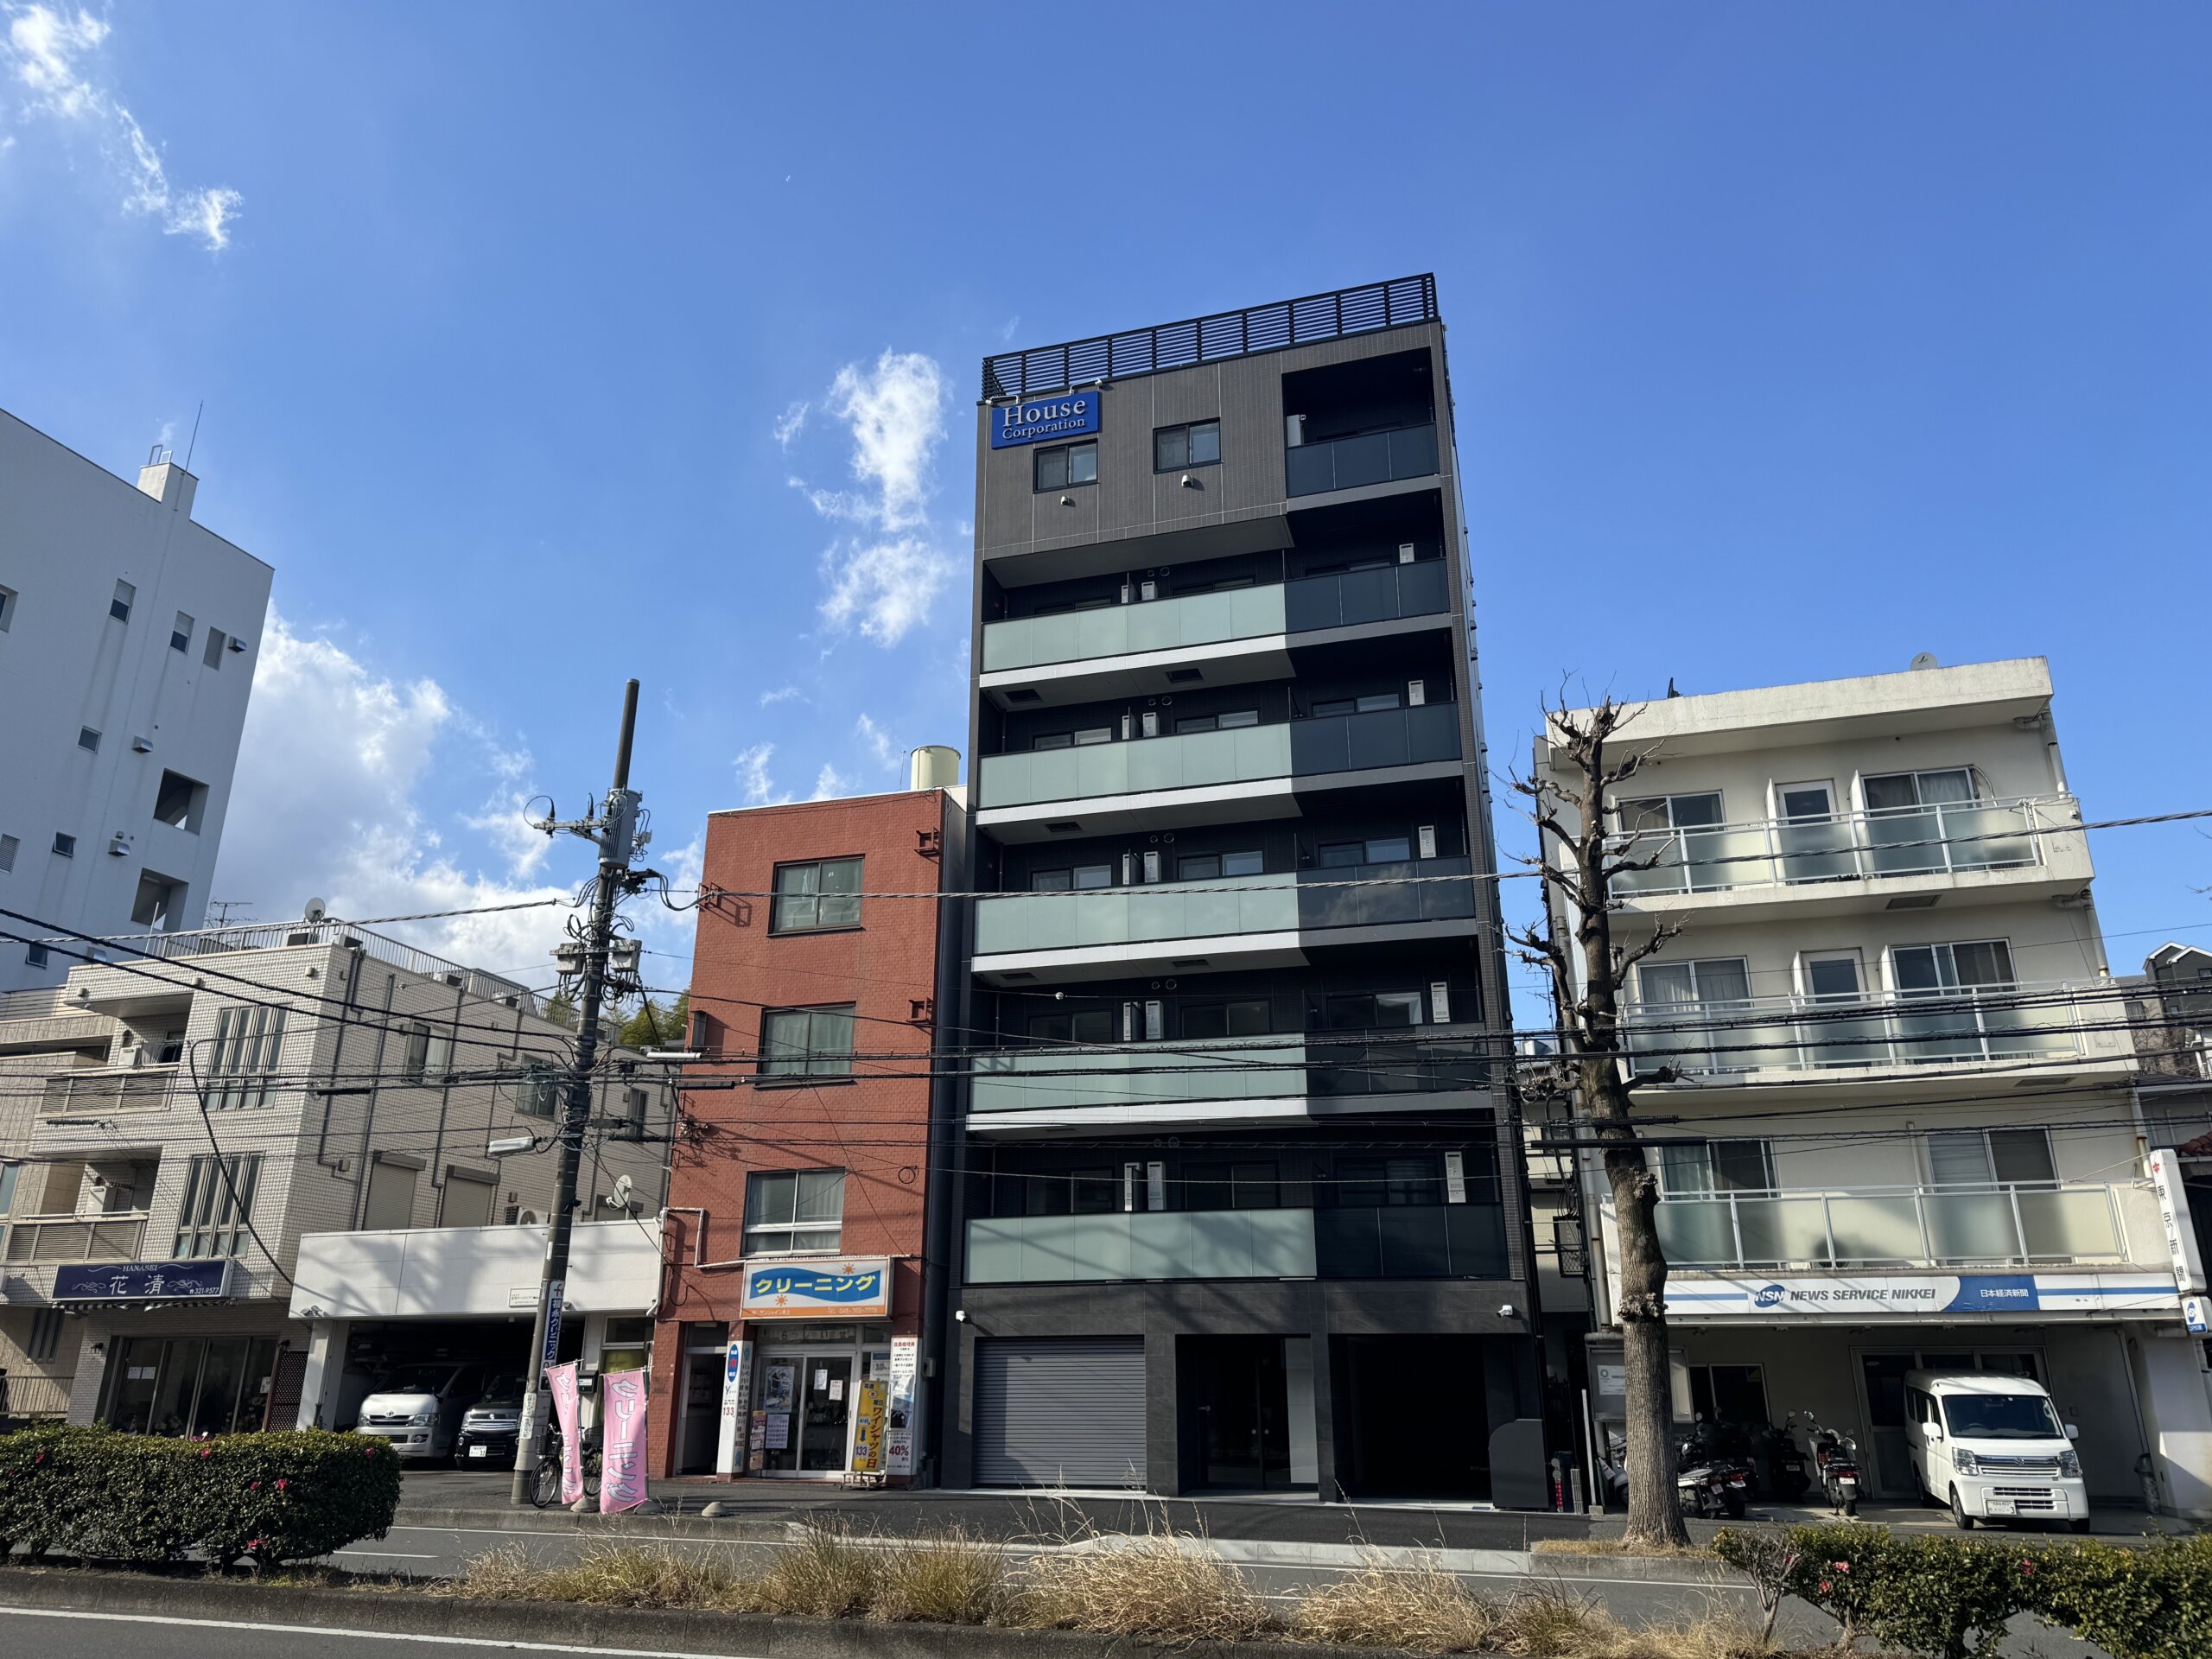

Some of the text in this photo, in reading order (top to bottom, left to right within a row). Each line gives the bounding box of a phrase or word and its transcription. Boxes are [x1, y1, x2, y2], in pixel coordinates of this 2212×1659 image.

[1002, 399, 1086, 428] House
[1002, 418, 1086, 439] Corporation
[2157, 1185, 2186, 1282] 東京新聞
[755, 1275, 876, 1294] クリーニング
[1980, 1288, 2029, 1298] 日本経済新聞
[1755, 1288, 1936, 1302] NSN NEWS SERVICE NIKKEI
[546, 1300, 563, 1359] 福永クリニック
[722, 1407, 734, 1416] 133
[606, 1379, 639, 1503] クリーニング
[866, 1407, 883, 1469] ワイシャツの日
[855, 1446, 868, 1456] 133
[889, 1445, 910, 1456] 40%
